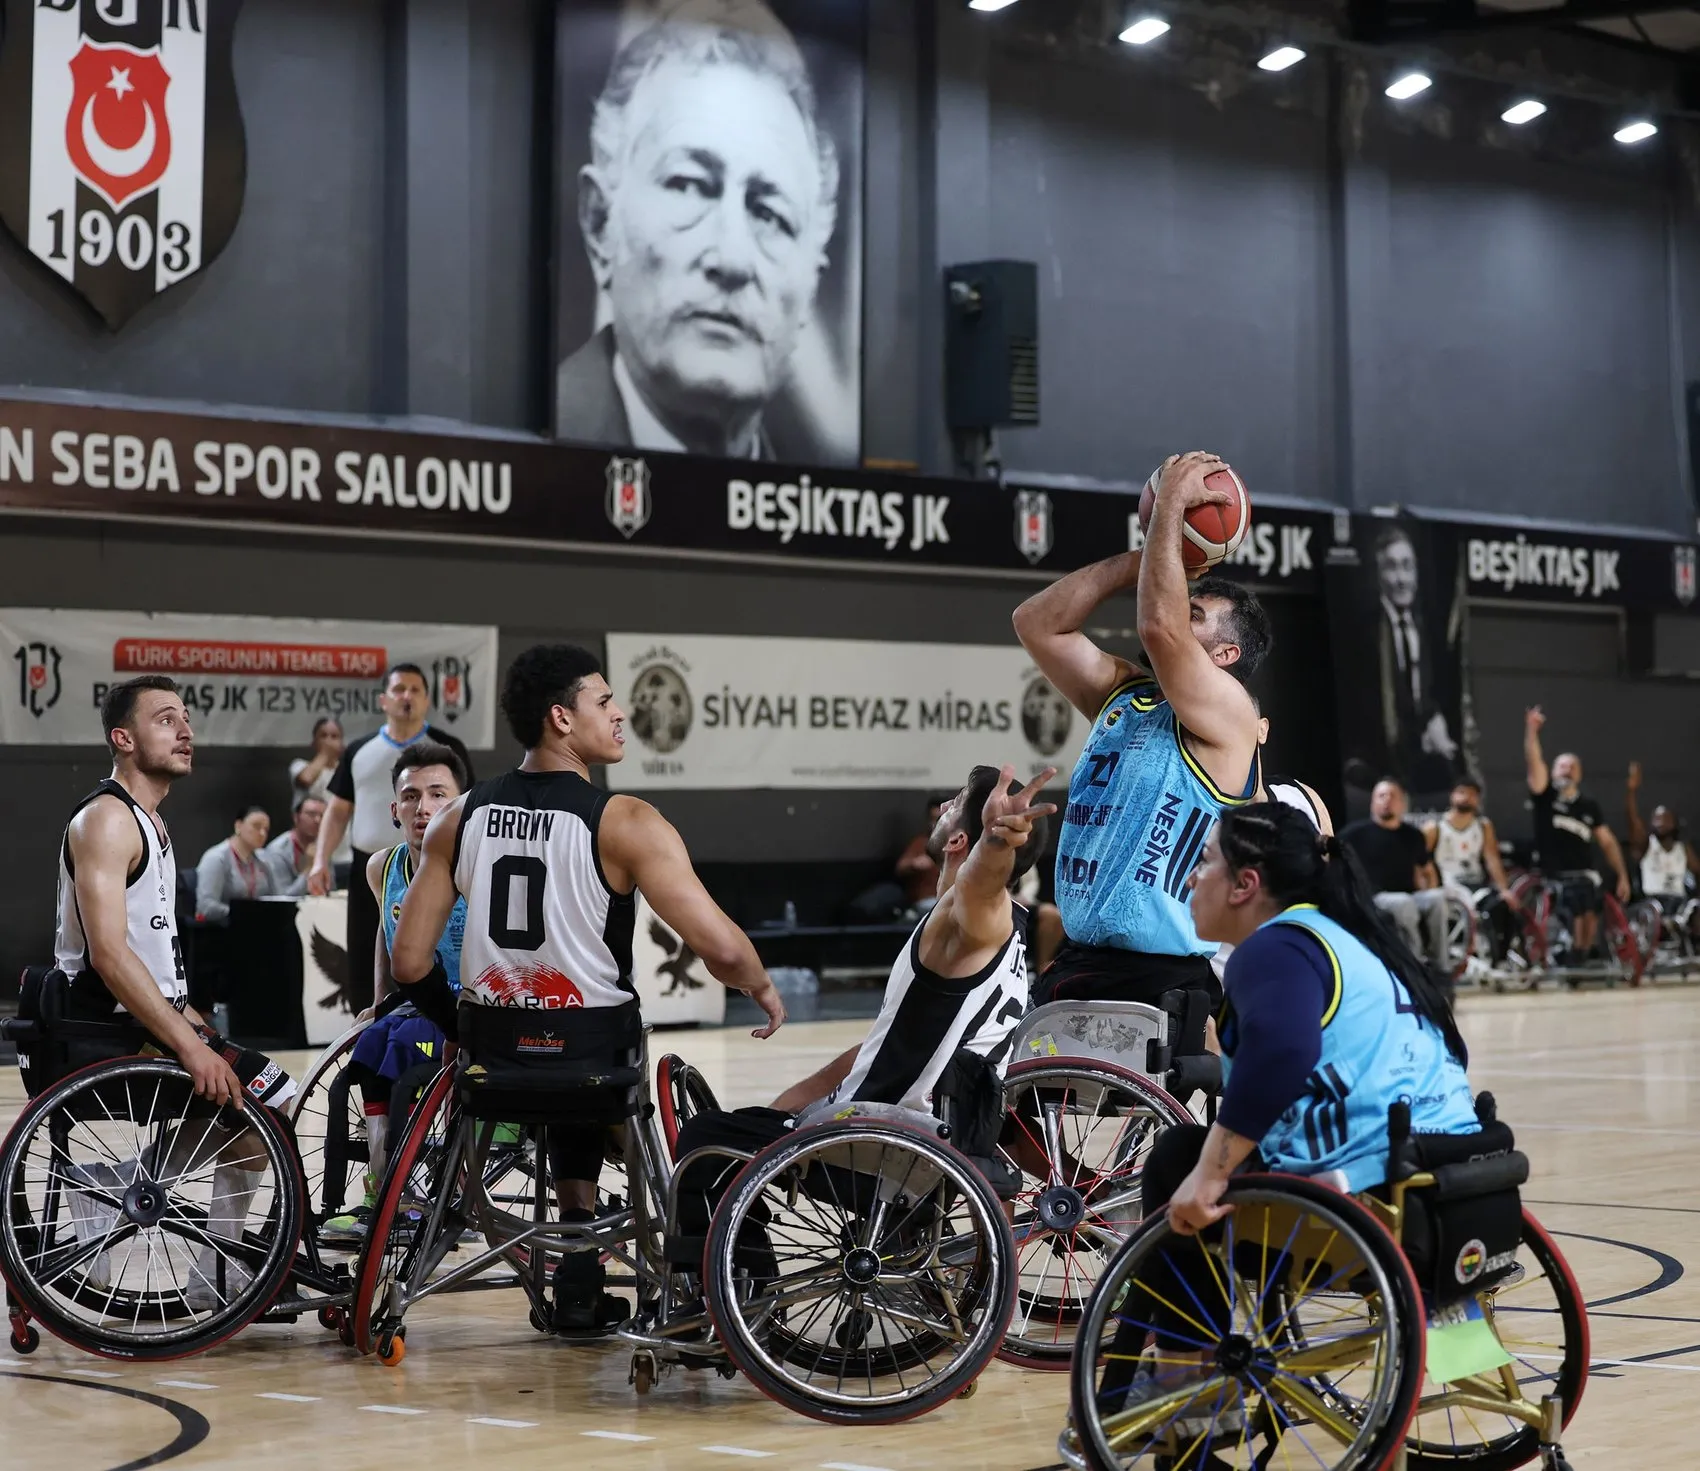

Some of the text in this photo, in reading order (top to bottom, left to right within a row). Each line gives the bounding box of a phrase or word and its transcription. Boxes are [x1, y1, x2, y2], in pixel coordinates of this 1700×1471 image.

[46, 209, 192, 273] 1903
[50, 431, 180, 492] SEBA
[193, 441, 322, 501] SPOR
[335, 452, 512, 515] SALONU
[727, 474, 951, 551] BEŞİKTAŞ JK
[1279, 525, 1313, 577] JK
[1467, 533, 1620, 598] BEŞİKTAŞ JK
[125, 644, 377, 677] TÜRK SPORUNUN TEMEL TAŞI
[221, 685, 248, 711] JK
[257, 686, 296, 713] 123
[702, 684, 1012, 732] SİYAH BEYAZ MİRAS
[487, 808, 555, 842] BROWN
[488, 854, 548, 952] 0
[483, 993, 584, 1011] MARCA
